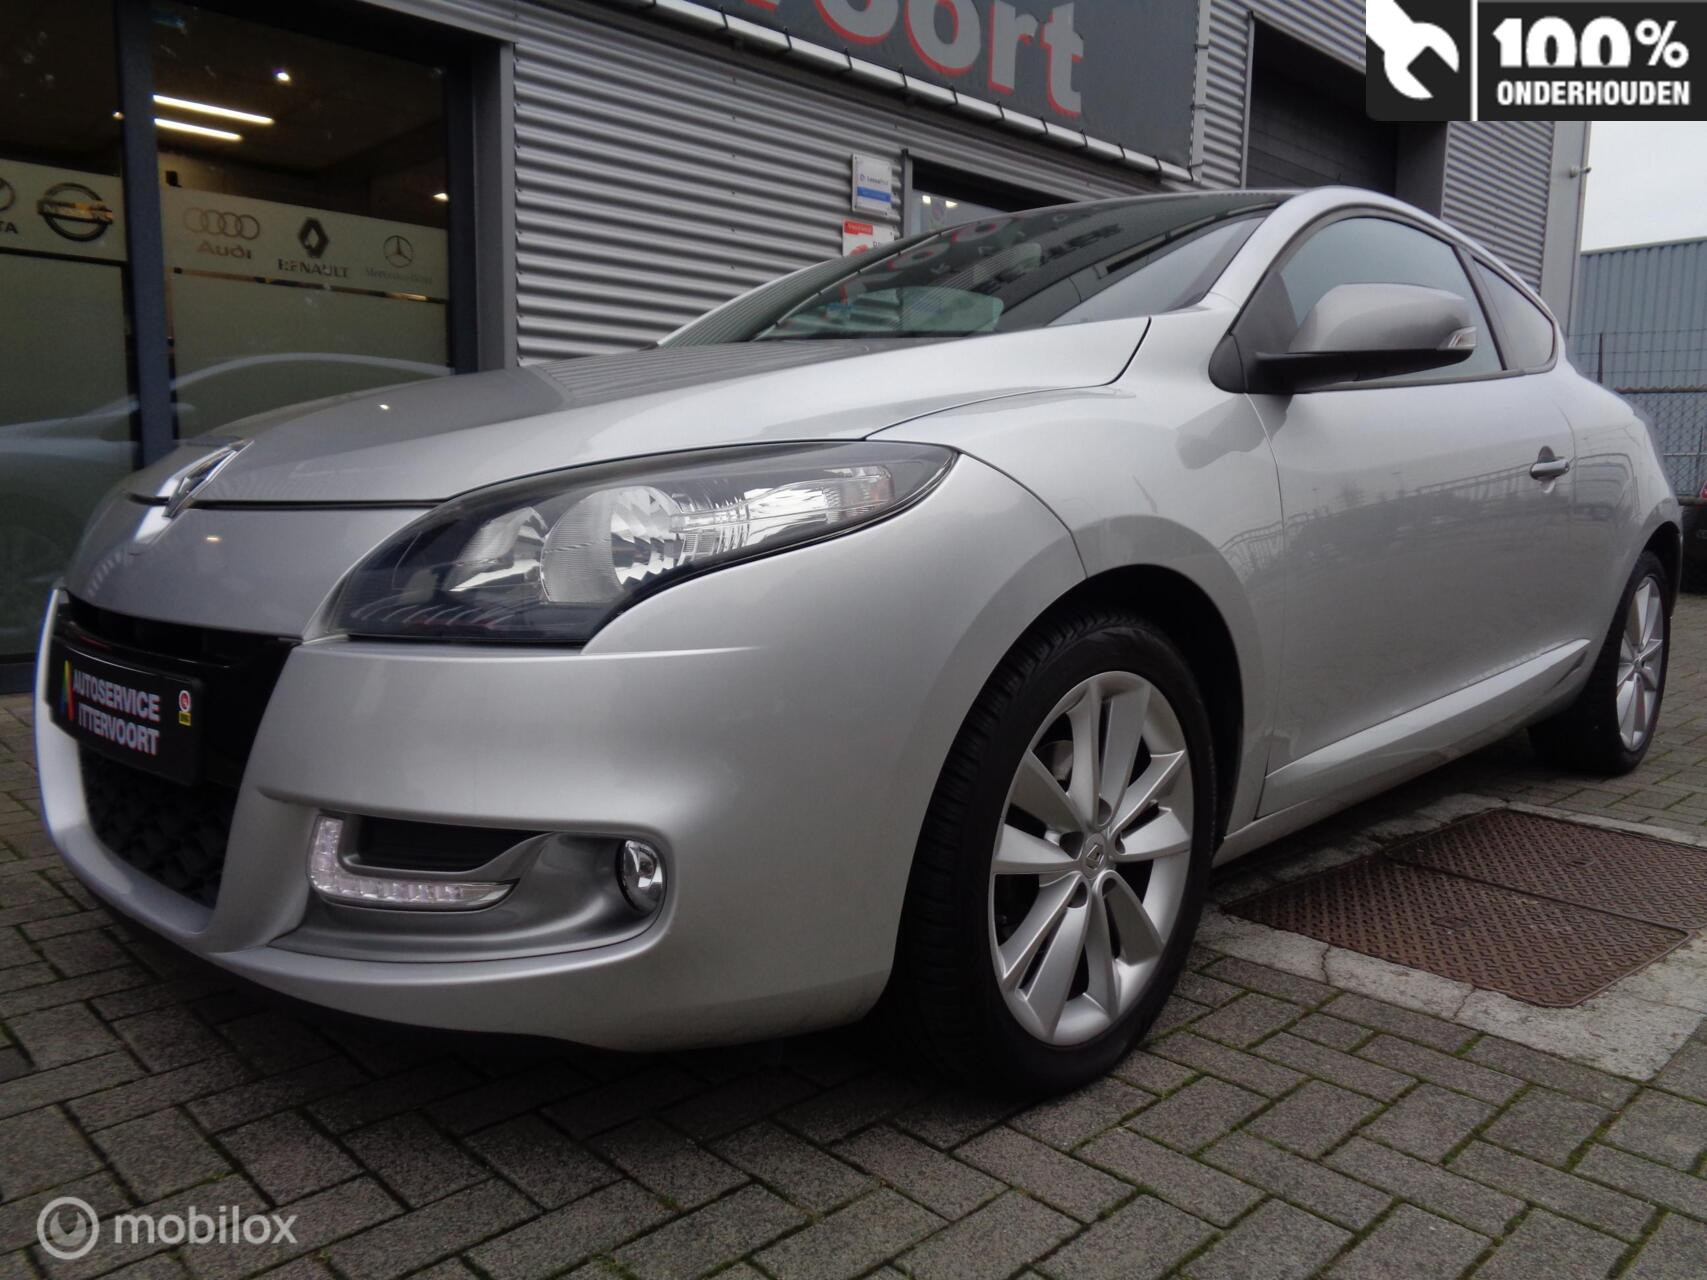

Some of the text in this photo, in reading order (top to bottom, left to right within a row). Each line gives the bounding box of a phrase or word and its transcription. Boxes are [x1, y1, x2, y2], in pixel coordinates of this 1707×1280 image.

[197, 241, 252, 260] Audi
[278, 258, 350, 278] RENAULT
[73, 669, 160, 721] AUTOSERVICE
[78, 702, 160, 754] ITTERVOORT
